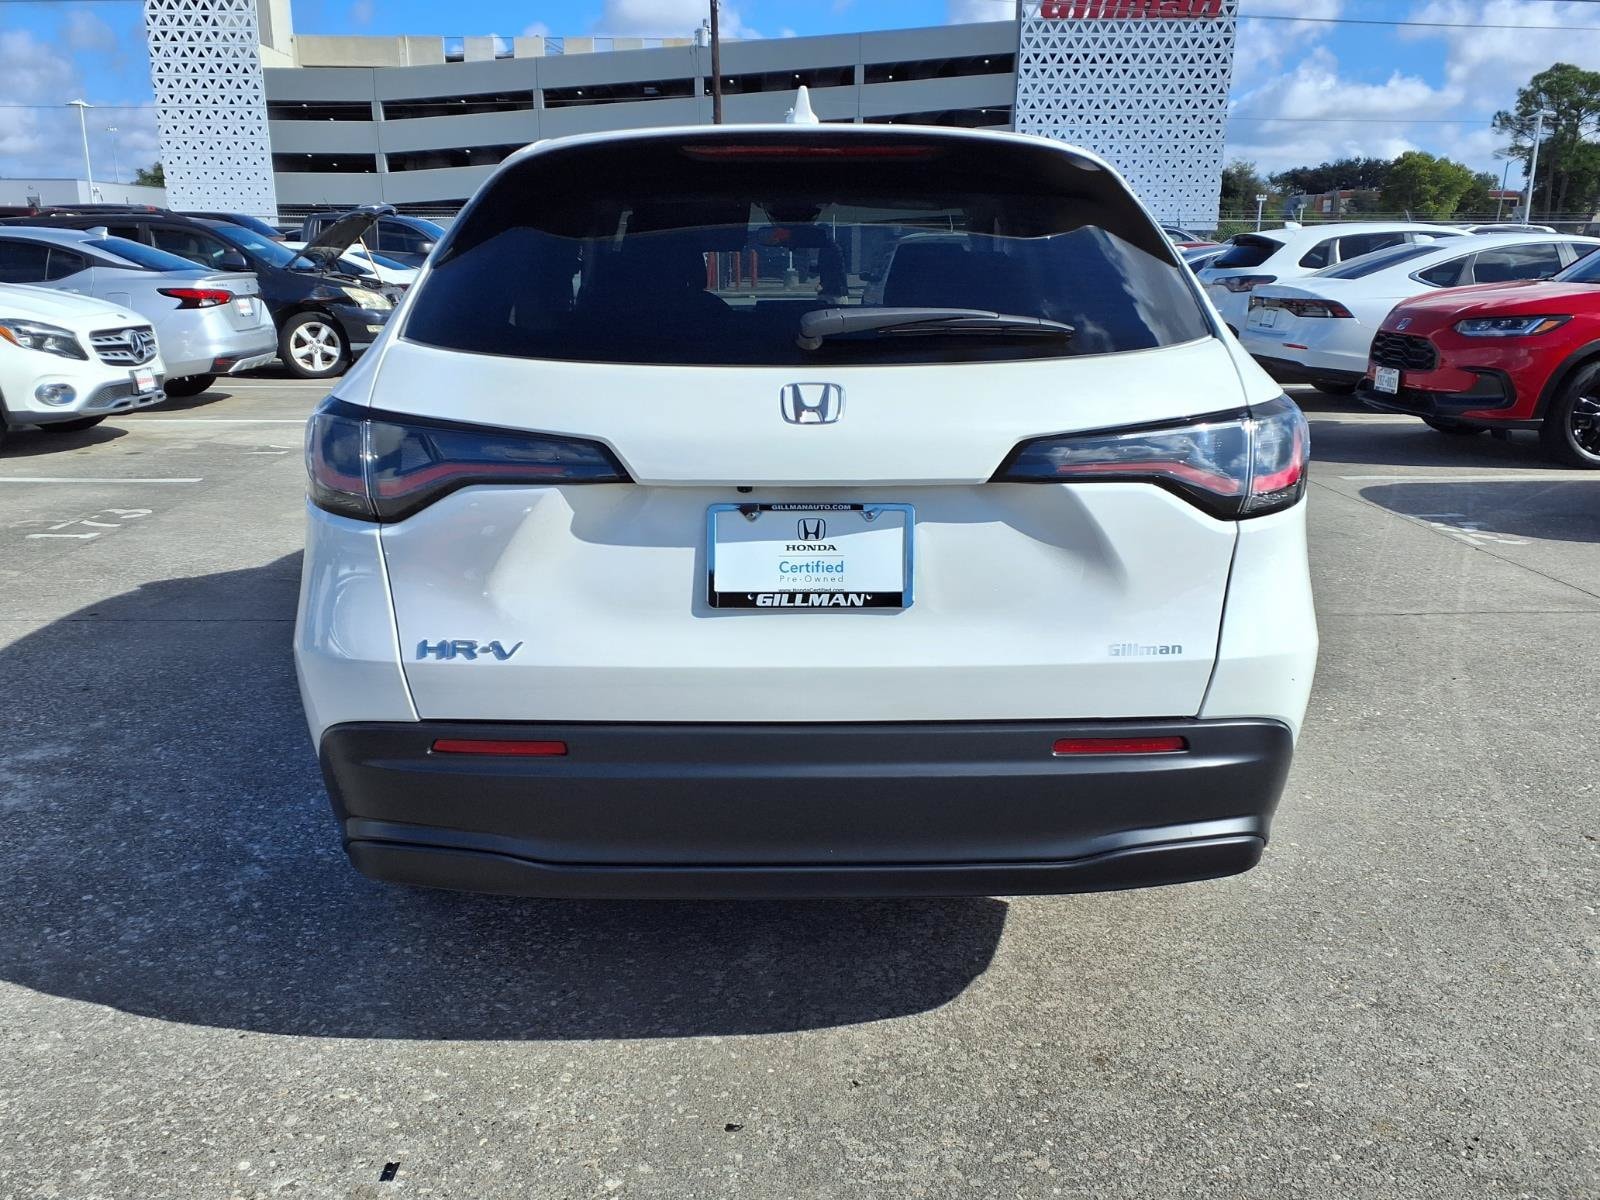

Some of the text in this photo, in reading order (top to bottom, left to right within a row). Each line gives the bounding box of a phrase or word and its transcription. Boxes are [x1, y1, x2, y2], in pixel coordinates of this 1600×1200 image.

[785, 544, 837, 552] HONDA
[779, 561, 844, 573] Certified
[779, 575, 844, 583] Pre-Owned
[756, 593, 865, 607] GILLMAN
[416, 639, 524, 660] HR-V
[1108, 643, 1182, 656] Gillman
